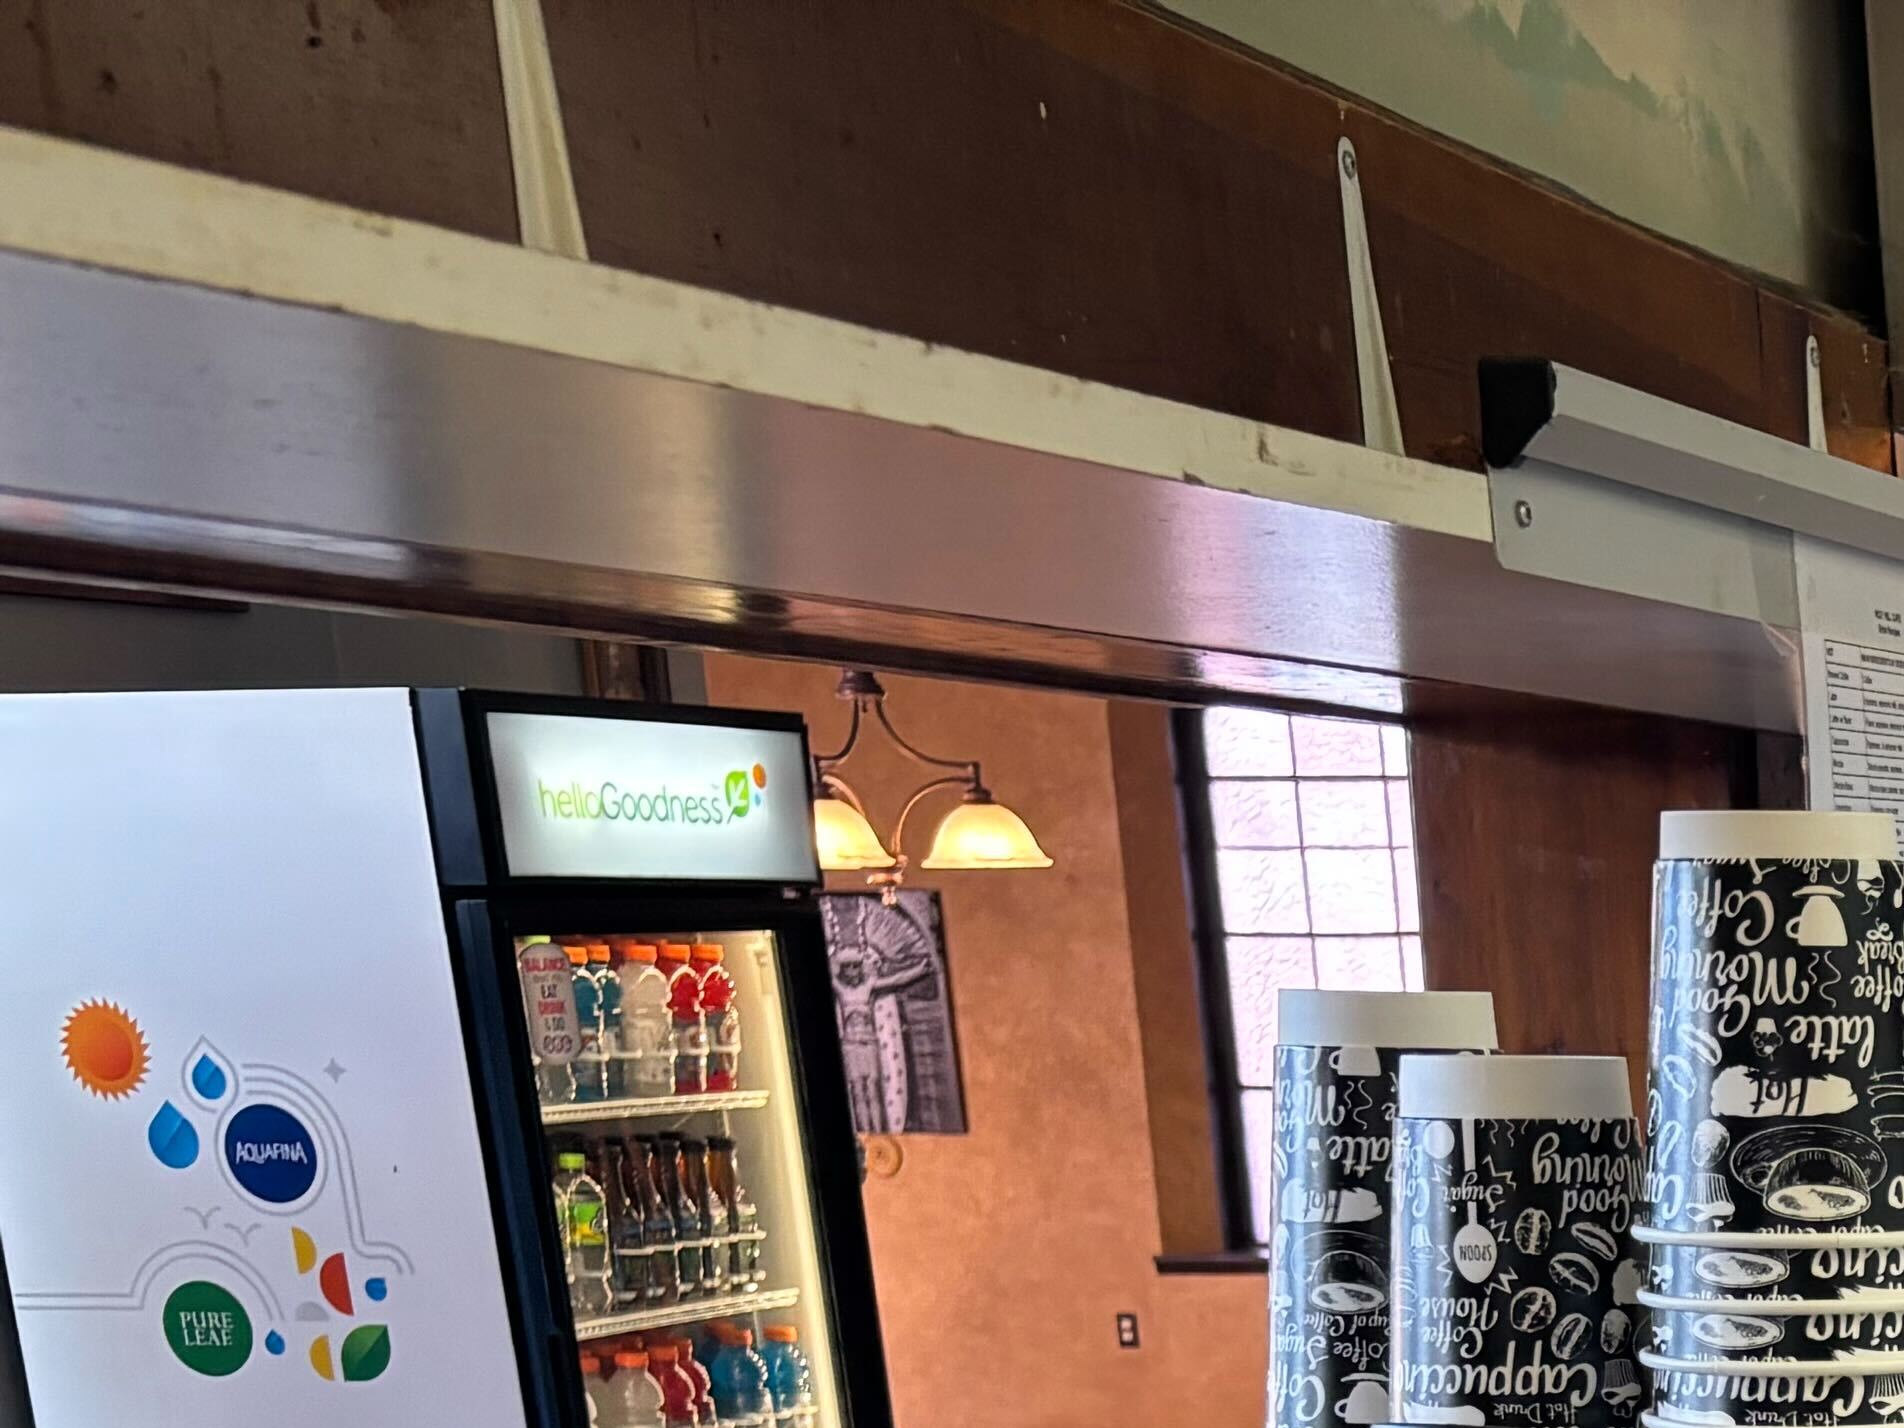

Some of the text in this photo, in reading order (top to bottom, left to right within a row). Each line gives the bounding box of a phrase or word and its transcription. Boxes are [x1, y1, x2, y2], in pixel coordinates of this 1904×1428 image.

[537, 778, 724, 825] helloGoodness
[1676, 878, 1776, 948] Coffee
[1661, 927, 1810, 1006] Morning
[1670, 984, 1752, 1038] Good
[1784, 1016, 1876, 1069] latte
[1746, 1079, 1809, 1117] Hot
[235, 1141, 308, 1165] AQUAFINA
[1560, 1185, 1630, 1234] Good
[1460, 1244, 1493, 1263] SPOON
[179, 1311, 235, 1328] PURE
[1421, 1297, 1499, 1332] House
[182, 1328, 234, 1347] LEAF
[1421, 1320, 1483, 1360] Coffee
[1495, 1402, 1579, 1426] Hot Drink
